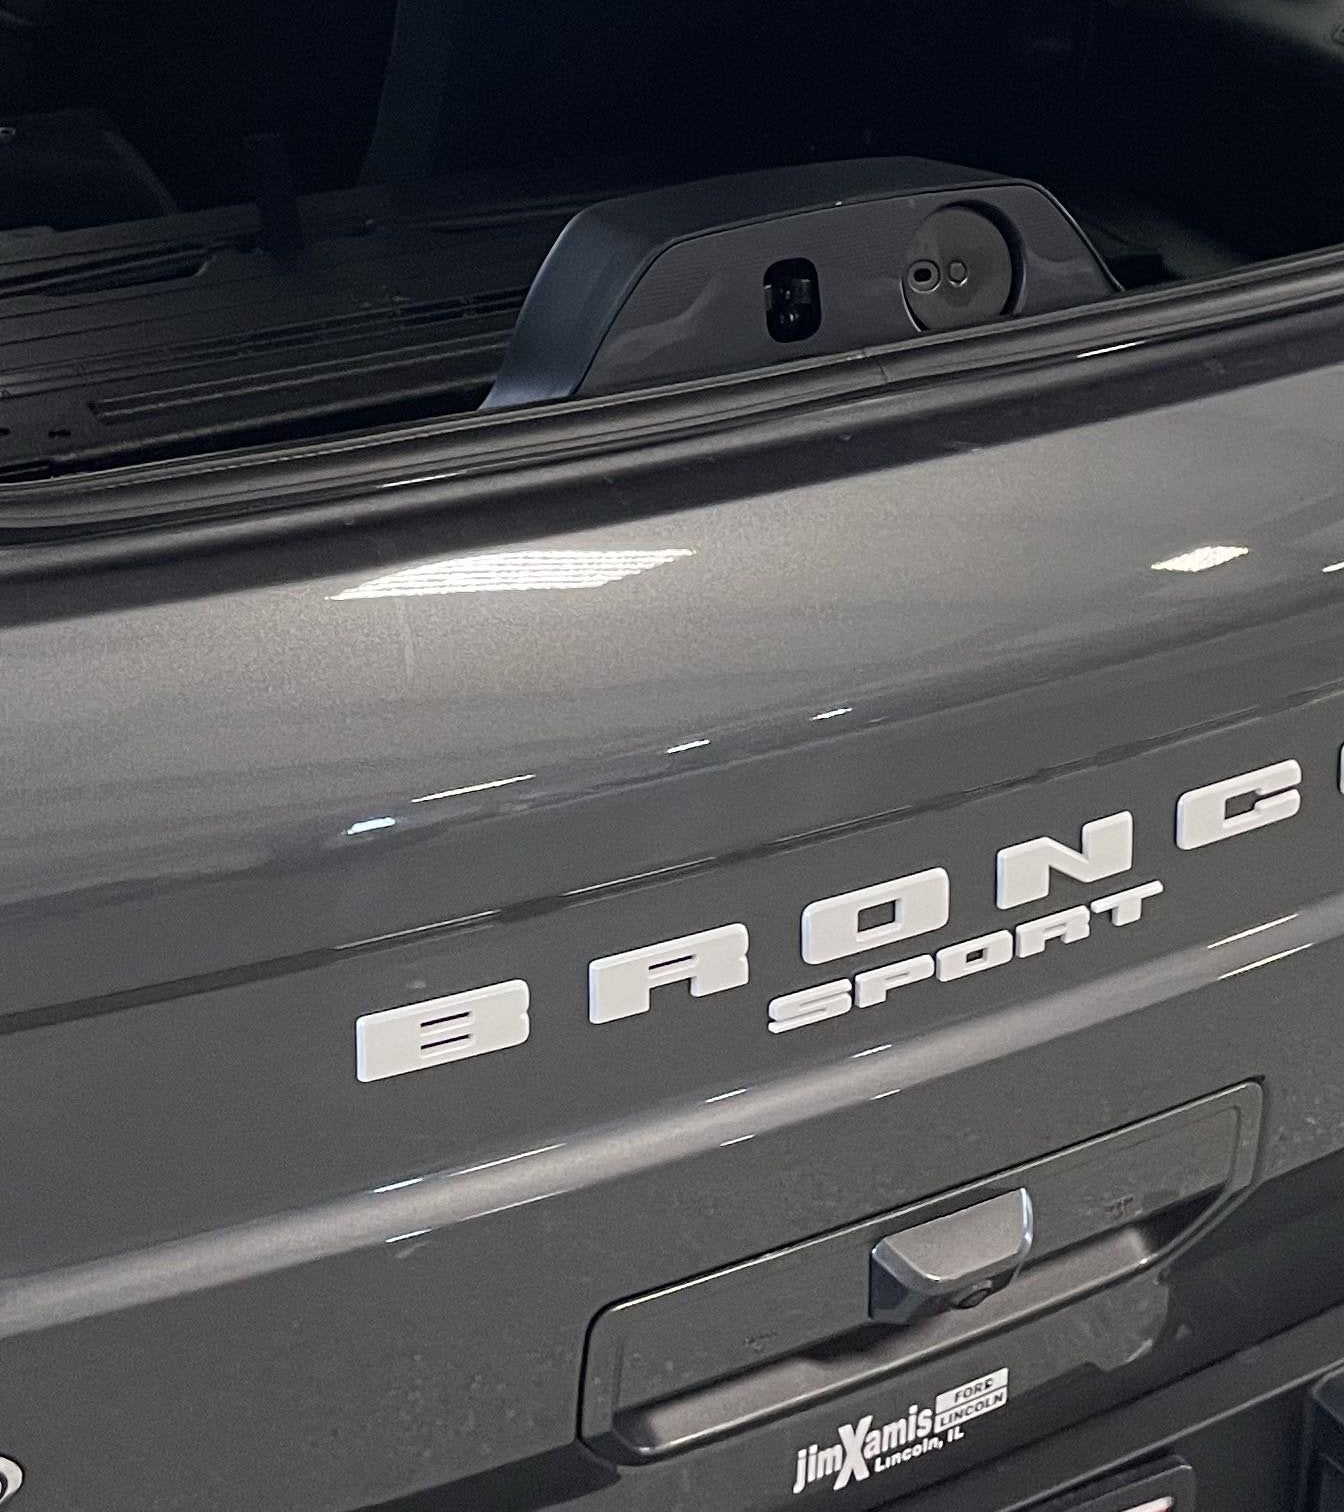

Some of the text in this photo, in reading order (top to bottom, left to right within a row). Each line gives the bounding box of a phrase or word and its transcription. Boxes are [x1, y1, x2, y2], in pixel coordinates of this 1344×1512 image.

[767, 879, 1165, 1034] SPORT
[955, 1377, 994, 1403] FORD
[940, 1391, 1005, 1428] LINCOLN
